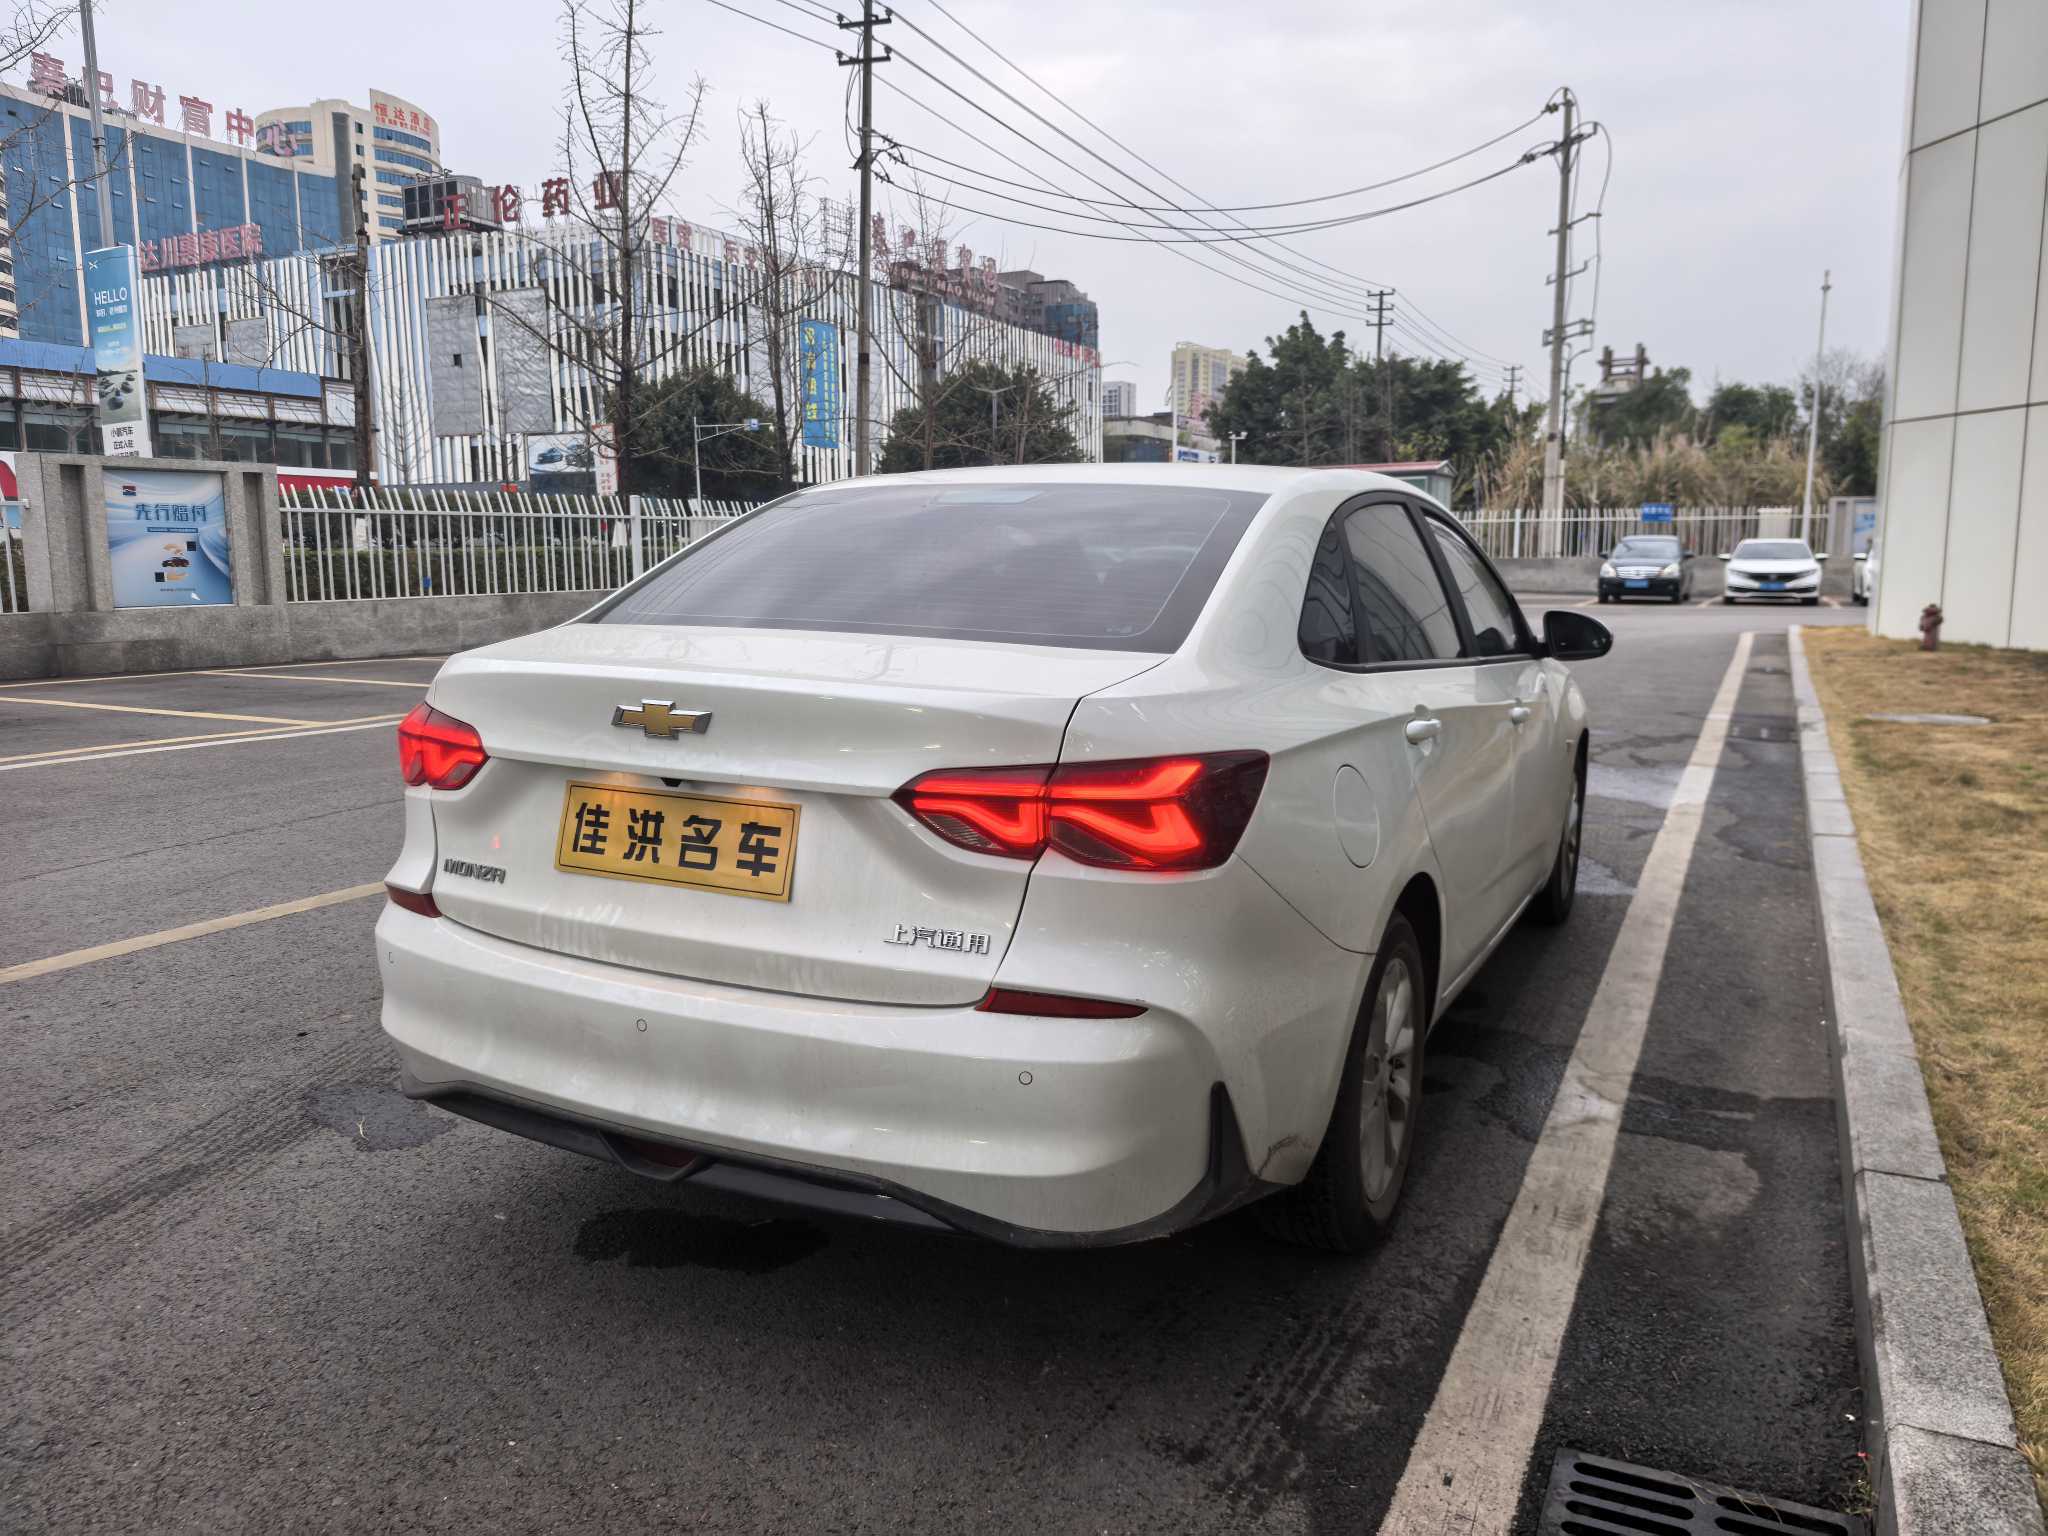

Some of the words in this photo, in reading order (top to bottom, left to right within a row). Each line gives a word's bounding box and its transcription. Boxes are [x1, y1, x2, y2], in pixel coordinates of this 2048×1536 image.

[440, 171, 623, 231] 正伦药业
[94, 287, 128, 305] HELLO
[136, 502, 207, 522] 先行赔付
[572, 802, 783, 877] 佳洪名车
[443, 858, 507, 884] MONZA
[883, 923, 990, 955] 上汽通用
